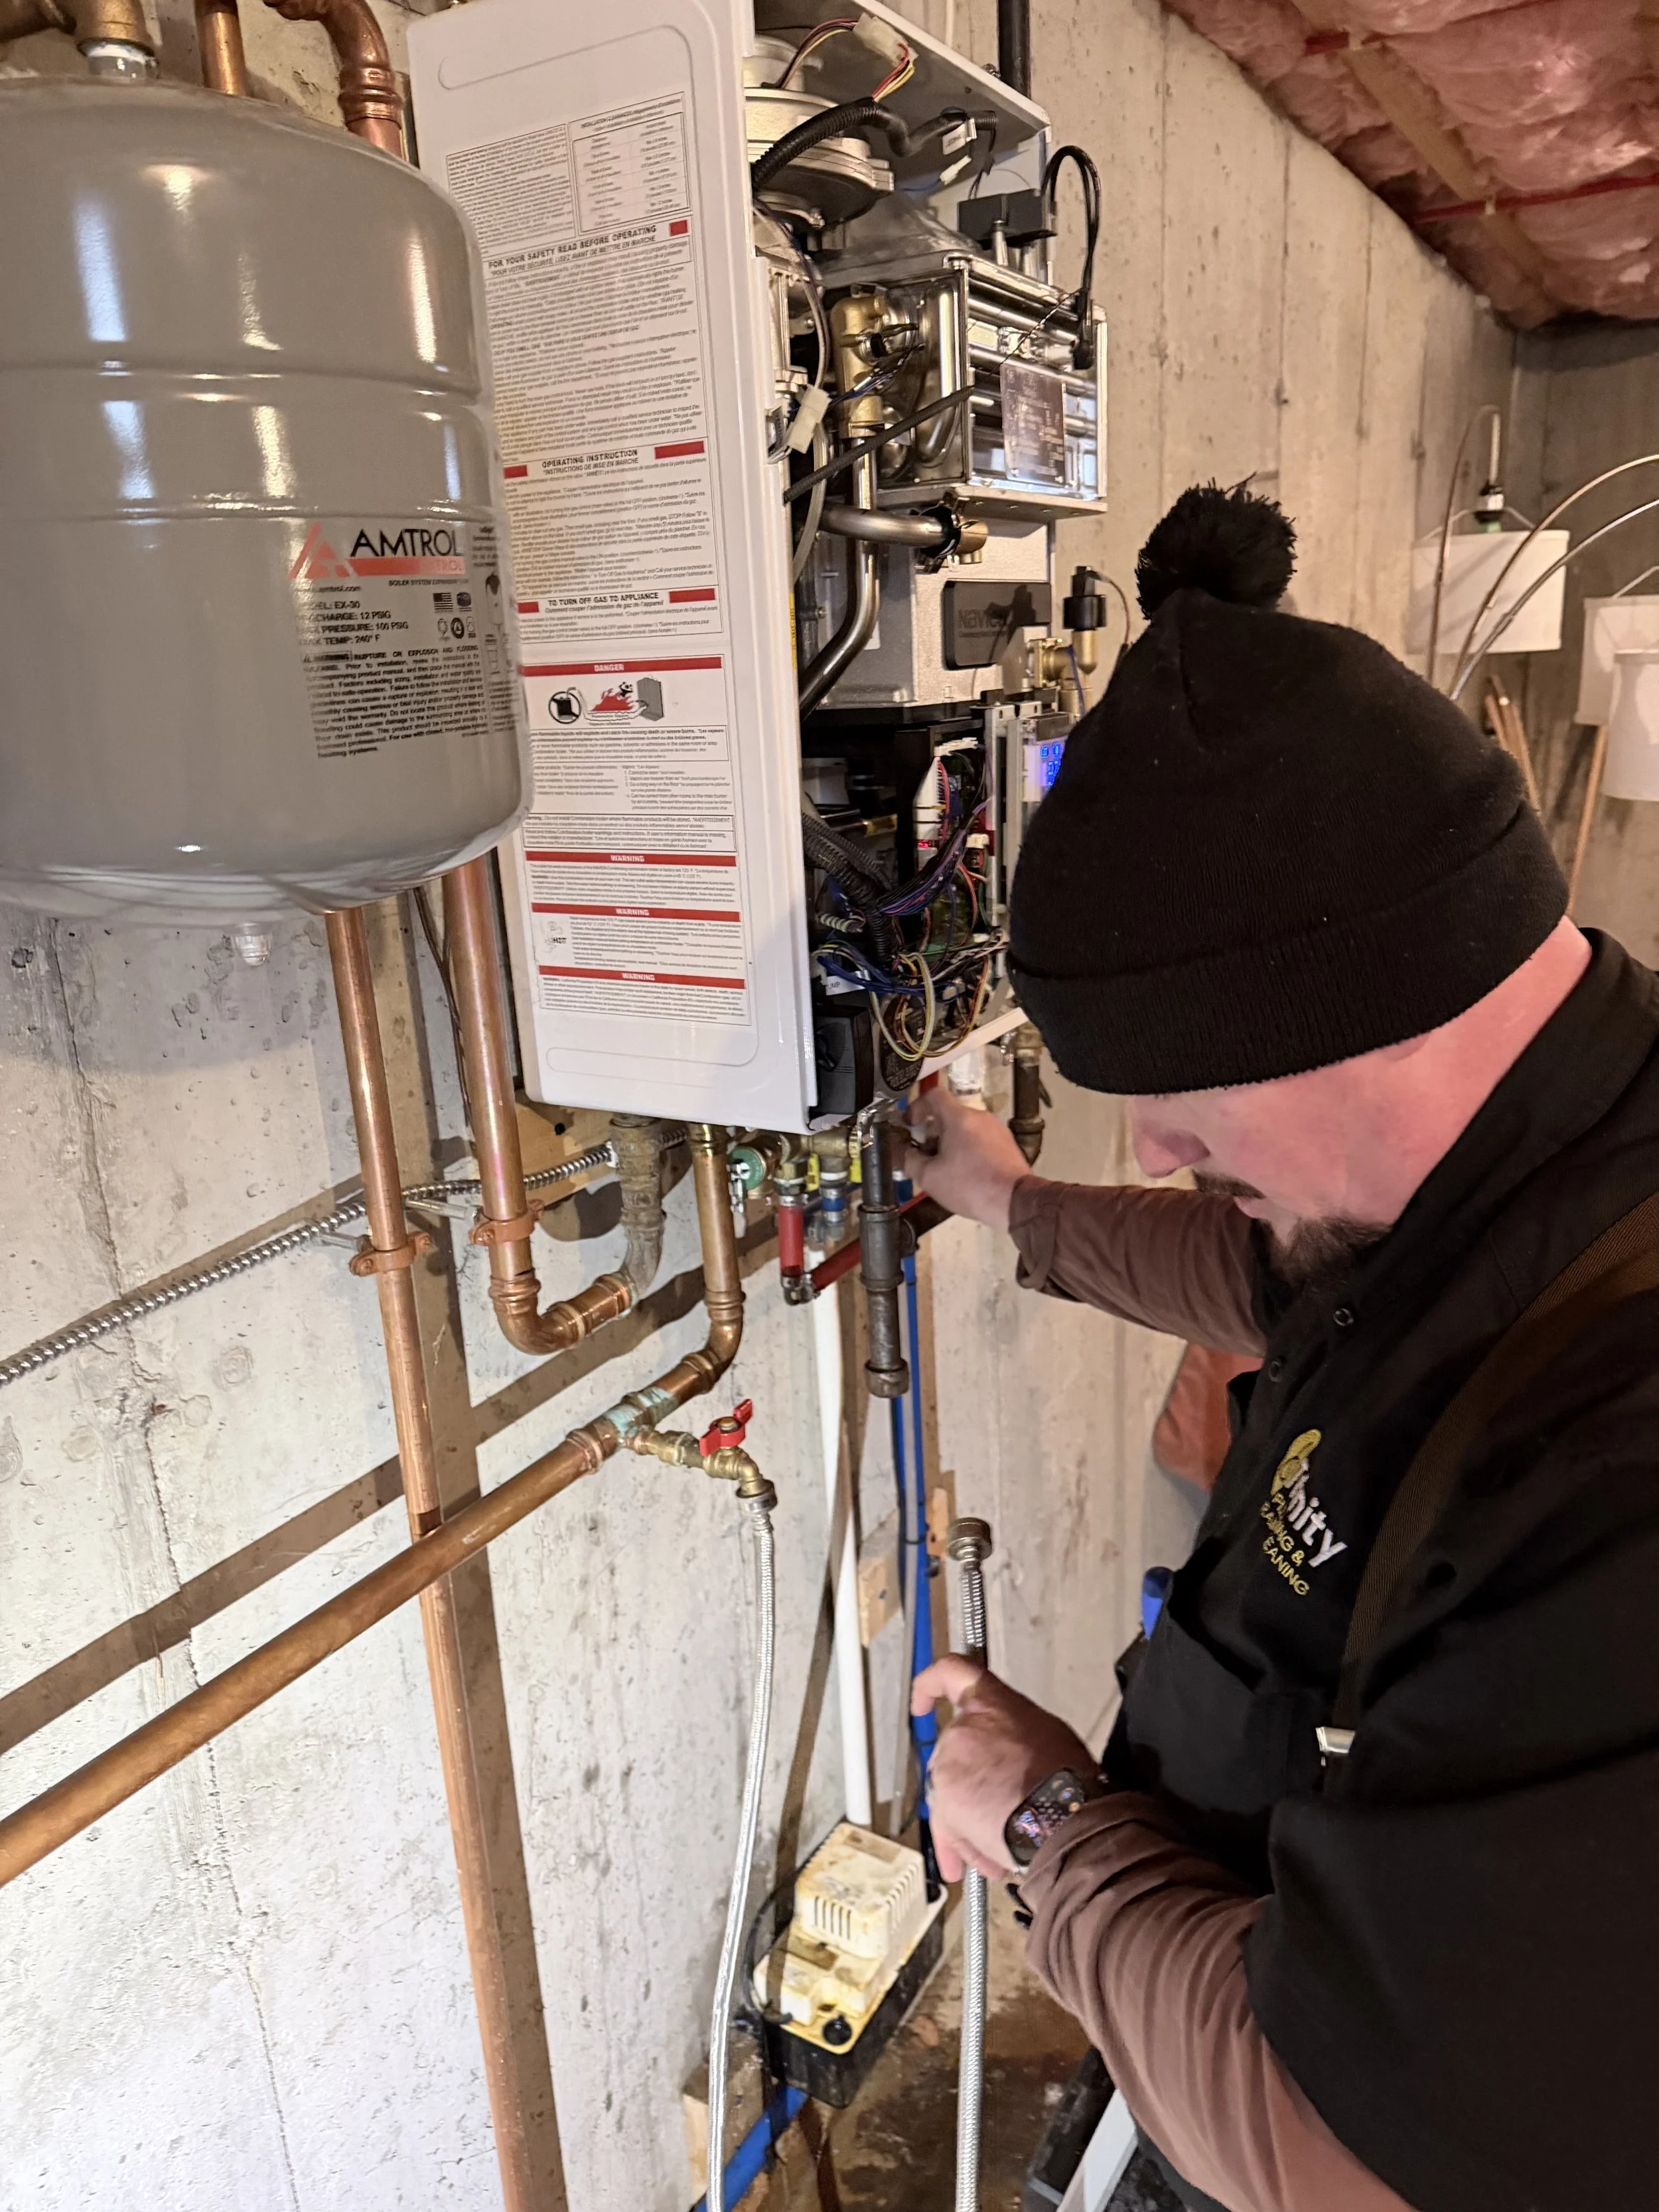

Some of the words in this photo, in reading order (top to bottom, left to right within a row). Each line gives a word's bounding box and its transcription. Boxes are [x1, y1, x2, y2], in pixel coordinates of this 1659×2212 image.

[488, 259, 504, 269] FOR
[506, 255, 526, 265] YOUR
[527, 248, 554, 260] SAFETY
[579, 235, 609, 248] BEFORE
[611, 225, 656, 241] OPERATING
[541, 456, 584, 468] OPERATING
[586, 449, 638, 462] INSTRUCTION
[615, 457, 639, 466] MARCHE
[350, 528, 463, 557] AMTROL
[620, 592, 659, 601] APPLIANCE
[360, 611, 369, 620] 12
[372, 611, 392, 619] PSIG
[321, 623, 374, 633] PRESSURE:
[391, 620, 409, 630] PSIG
[324, 636, 354, 645] TEMP:
[611, 854, 645, 863] WARNING
